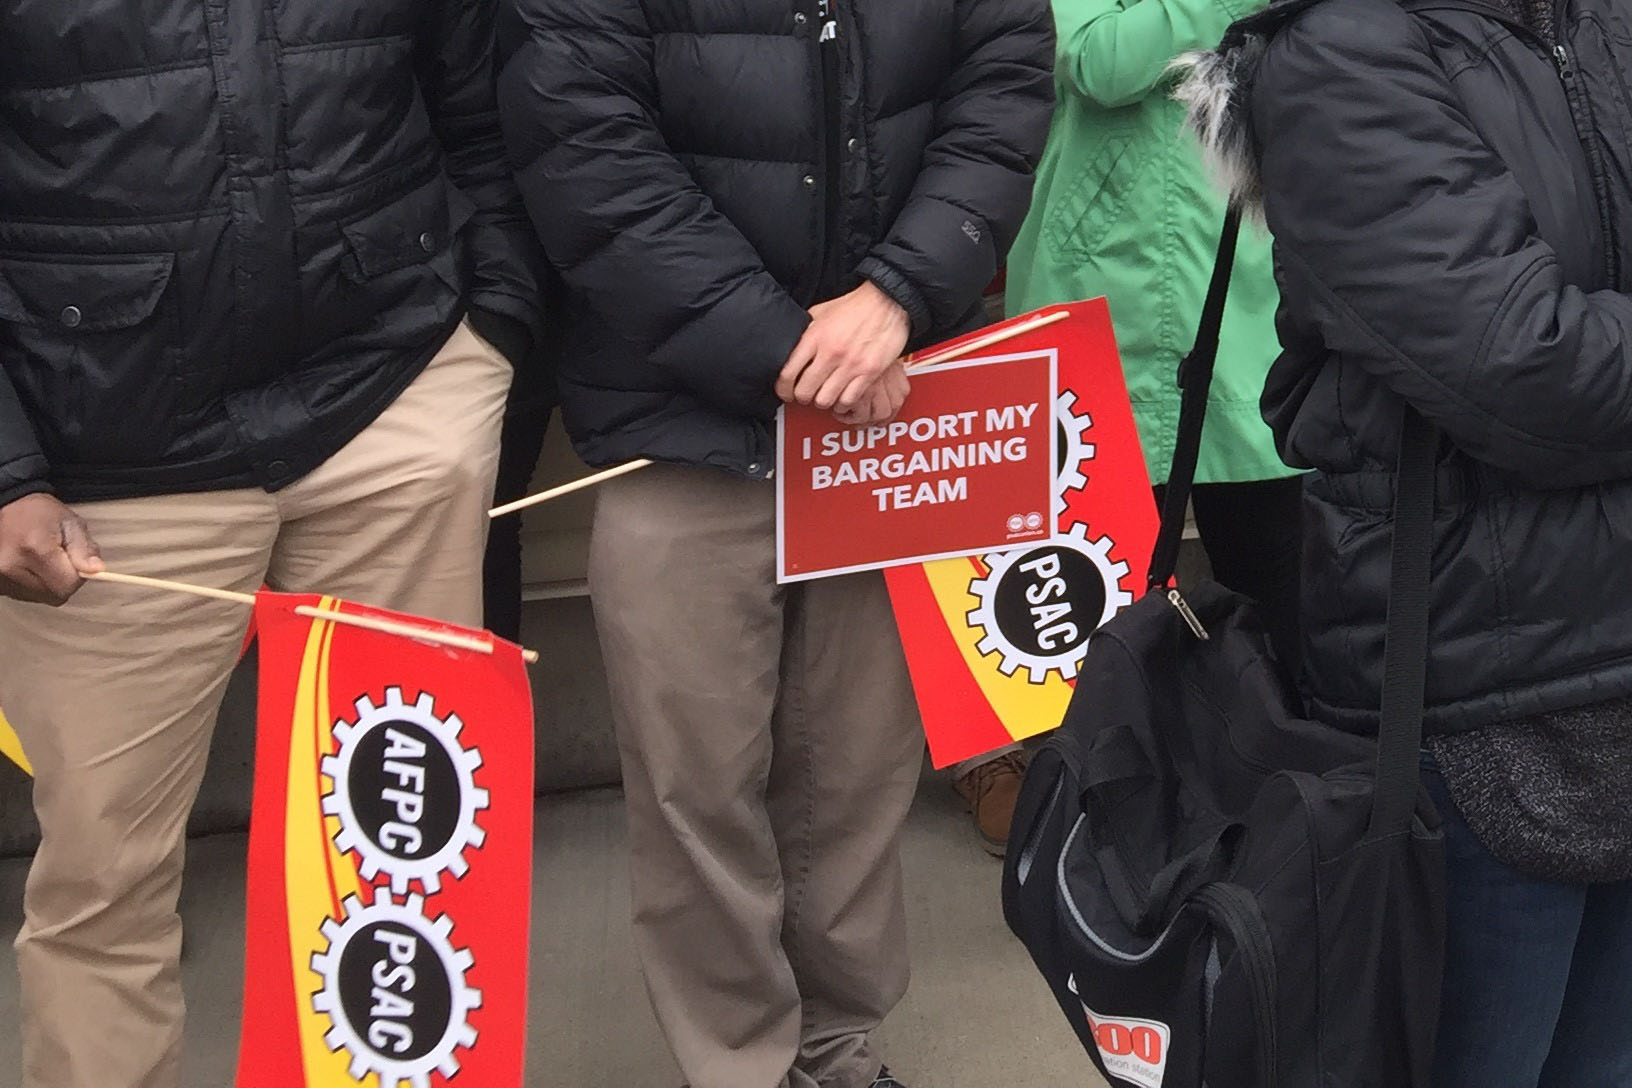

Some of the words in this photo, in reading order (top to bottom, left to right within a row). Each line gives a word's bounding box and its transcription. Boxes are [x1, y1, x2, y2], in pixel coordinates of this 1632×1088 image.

[802, 437, 812, 460] I
[820, 411, 979, 457] SUPPORT
[985, 402, 1039, 433] MY
[811, 437, 1027, 490] BARGAINING
[871, 476, 967, 512] TEAM
[1019, 552, 1078, 652] PSAC
[378, 727, 426, 855] AFPC
[367, 929, 416, 1054] PSAC
